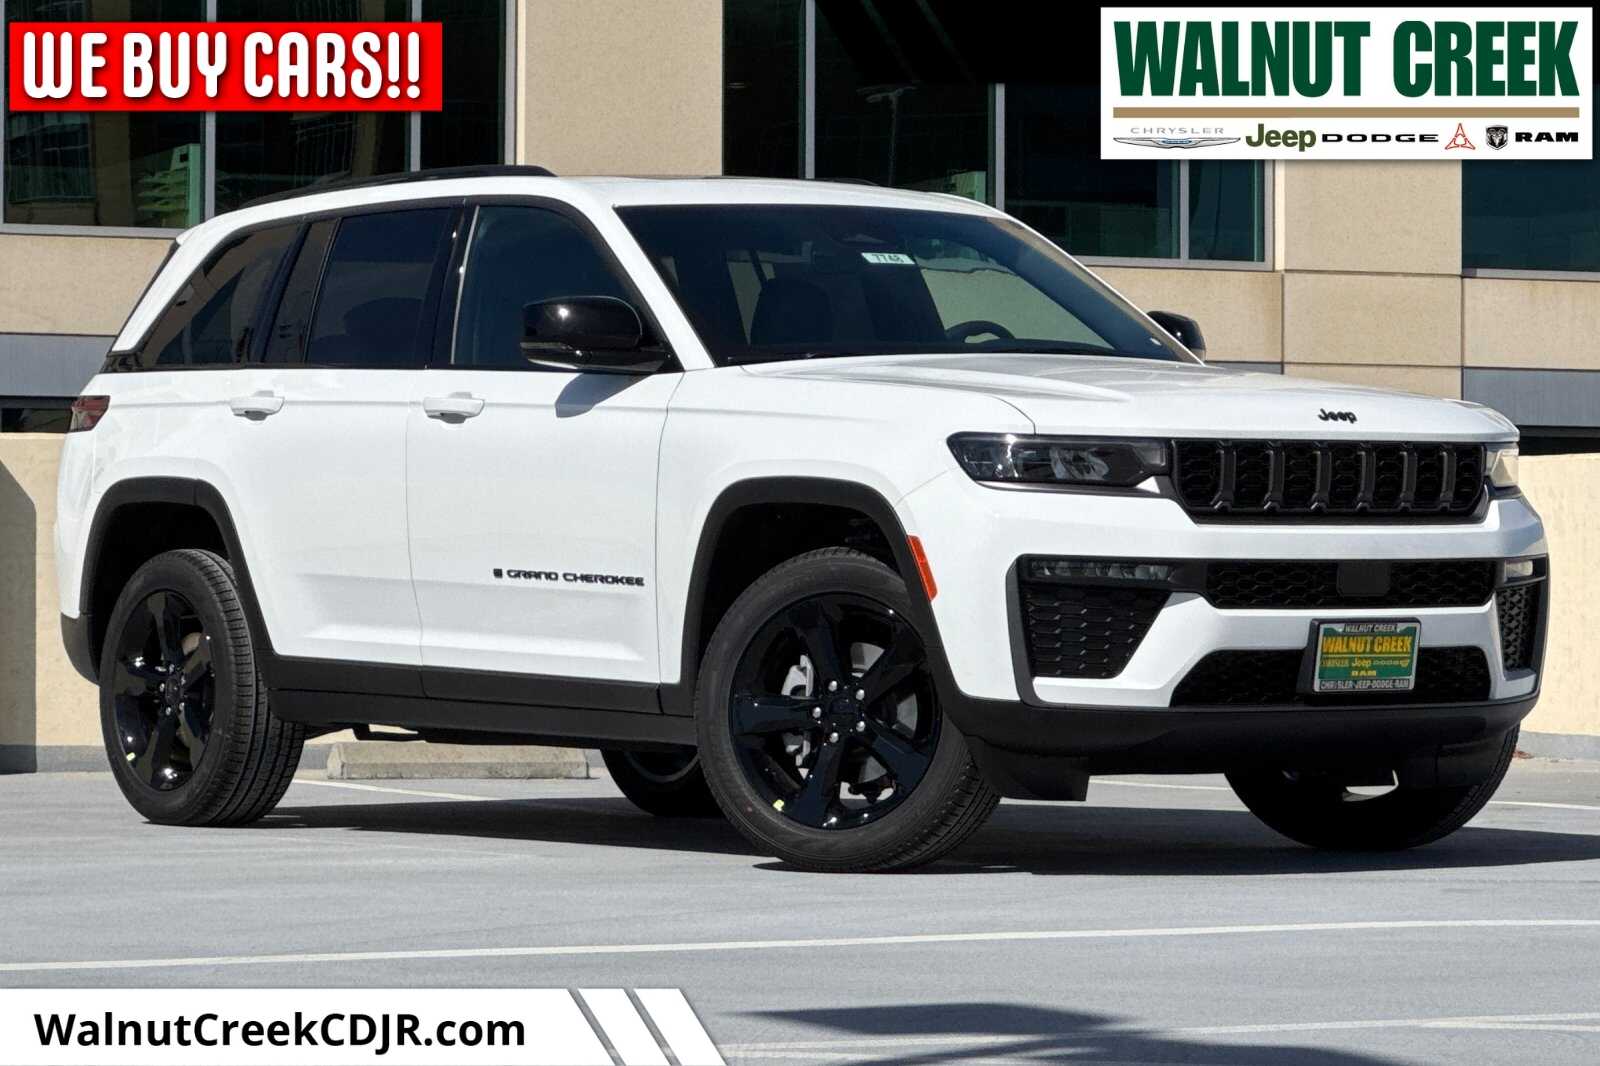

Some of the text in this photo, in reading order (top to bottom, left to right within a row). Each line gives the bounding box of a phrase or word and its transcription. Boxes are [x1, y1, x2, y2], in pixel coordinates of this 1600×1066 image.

[1317, 407, 1358, 424] Jeep
[506, 569, 645, 587] GRAND CHEROKEE
[1322, 636, 1413, 653] WALNUT CREEK
